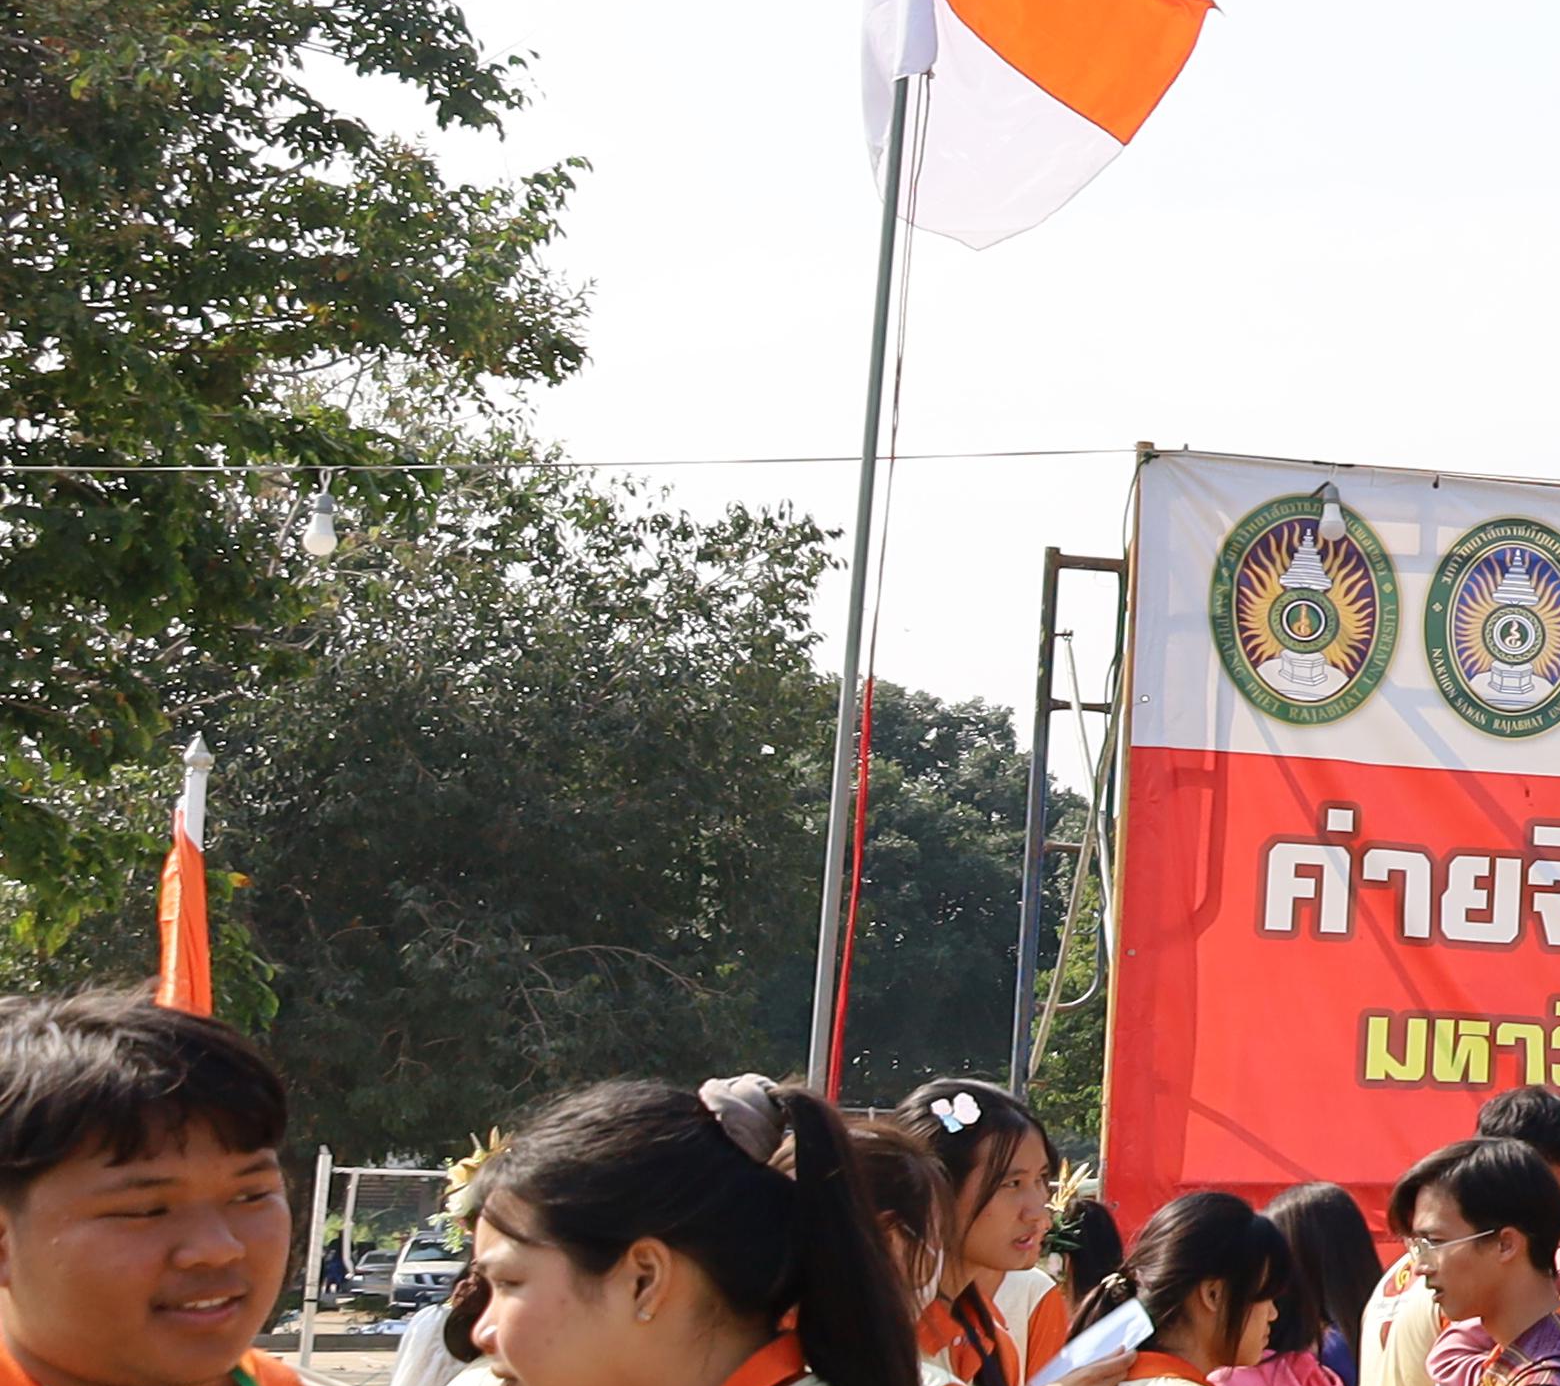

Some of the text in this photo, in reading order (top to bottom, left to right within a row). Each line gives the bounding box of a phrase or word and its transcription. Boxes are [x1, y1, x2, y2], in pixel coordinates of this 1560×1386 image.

[1245, 680, 1281, 714] PHET
[1288, 686, 1364, 723] RAJABHAT
[1364, 602, 1396, 686] UNIVERSITY
[1431, 647, 1458, 701] NAKHON
[1455, 696, 1487, 727] SAWAN
[1492, 714, 1546, 735] RAJABHAT
